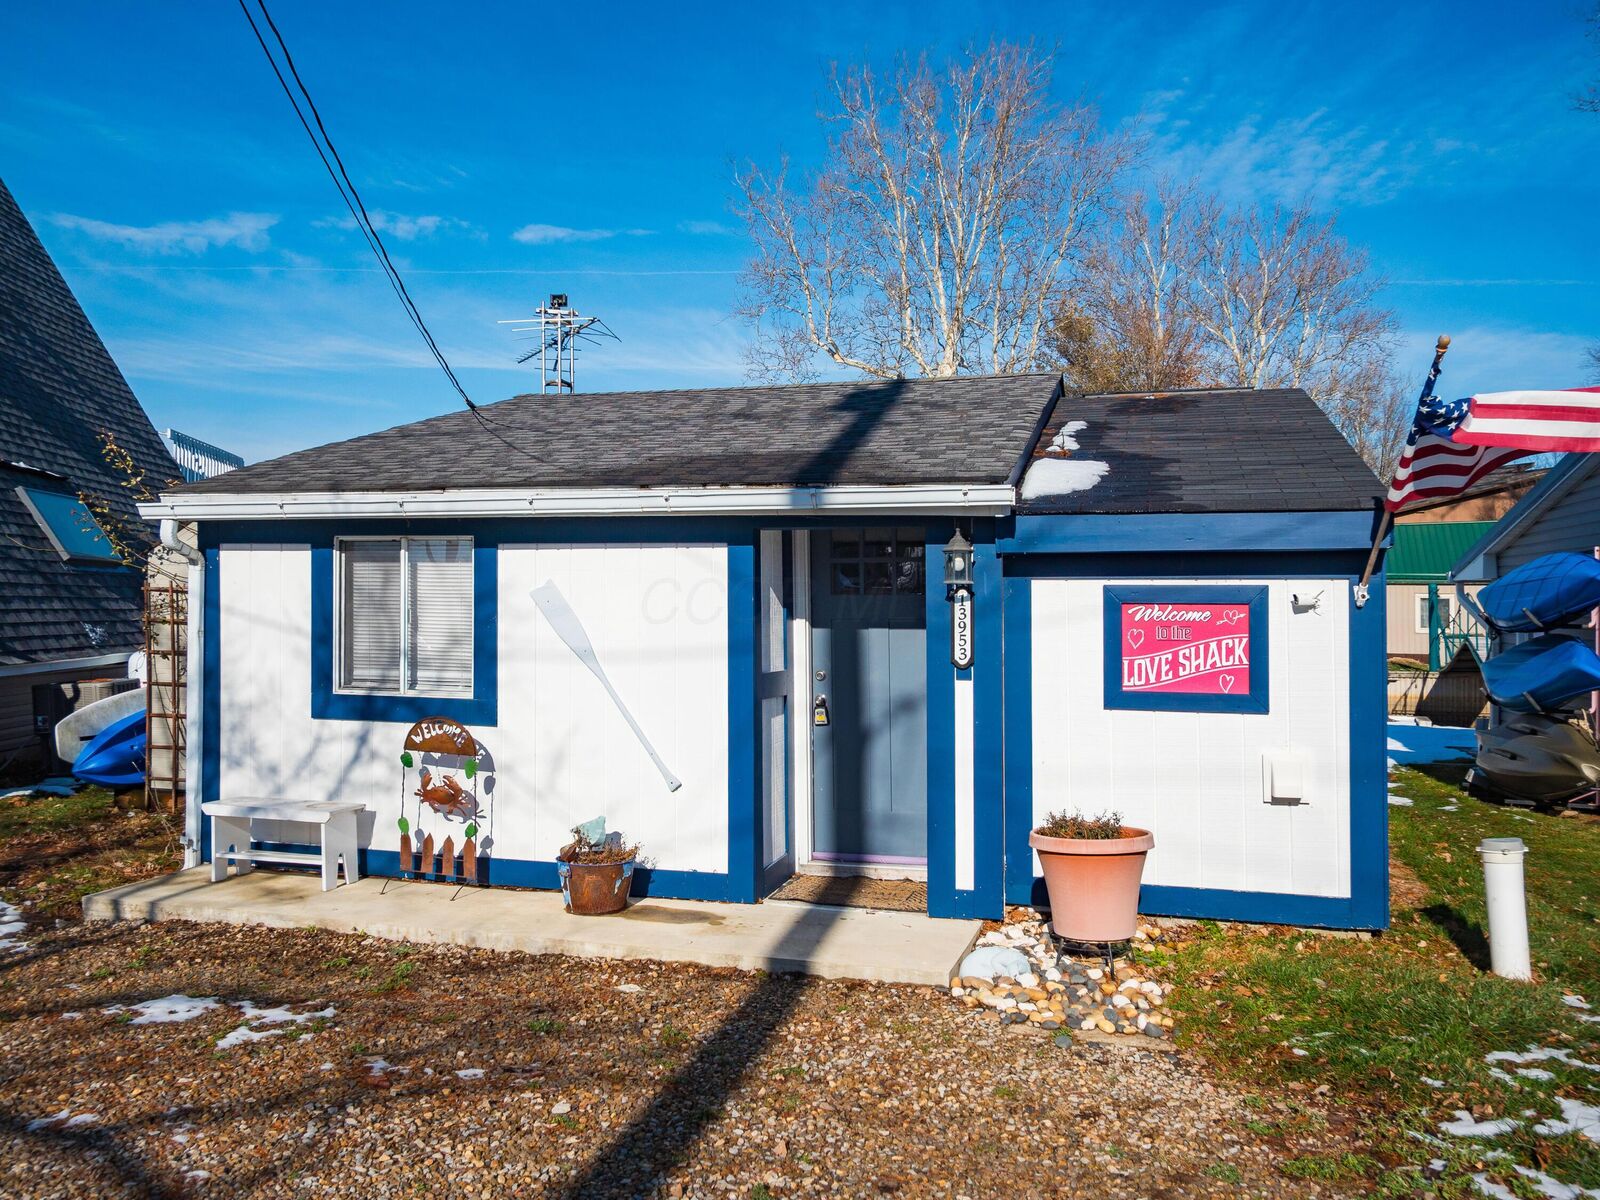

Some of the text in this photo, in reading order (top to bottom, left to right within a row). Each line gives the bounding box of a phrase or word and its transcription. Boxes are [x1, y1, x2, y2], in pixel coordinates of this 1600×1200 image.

[1128, 604, 1212, 622] Welcome
[957, 594, 967, 660] 13953
[1155, 625, 1192, 640] to the
[1122, 637, 1250, 686] LOVE SHACK
[410, 723, 467, 747] WELCOME
